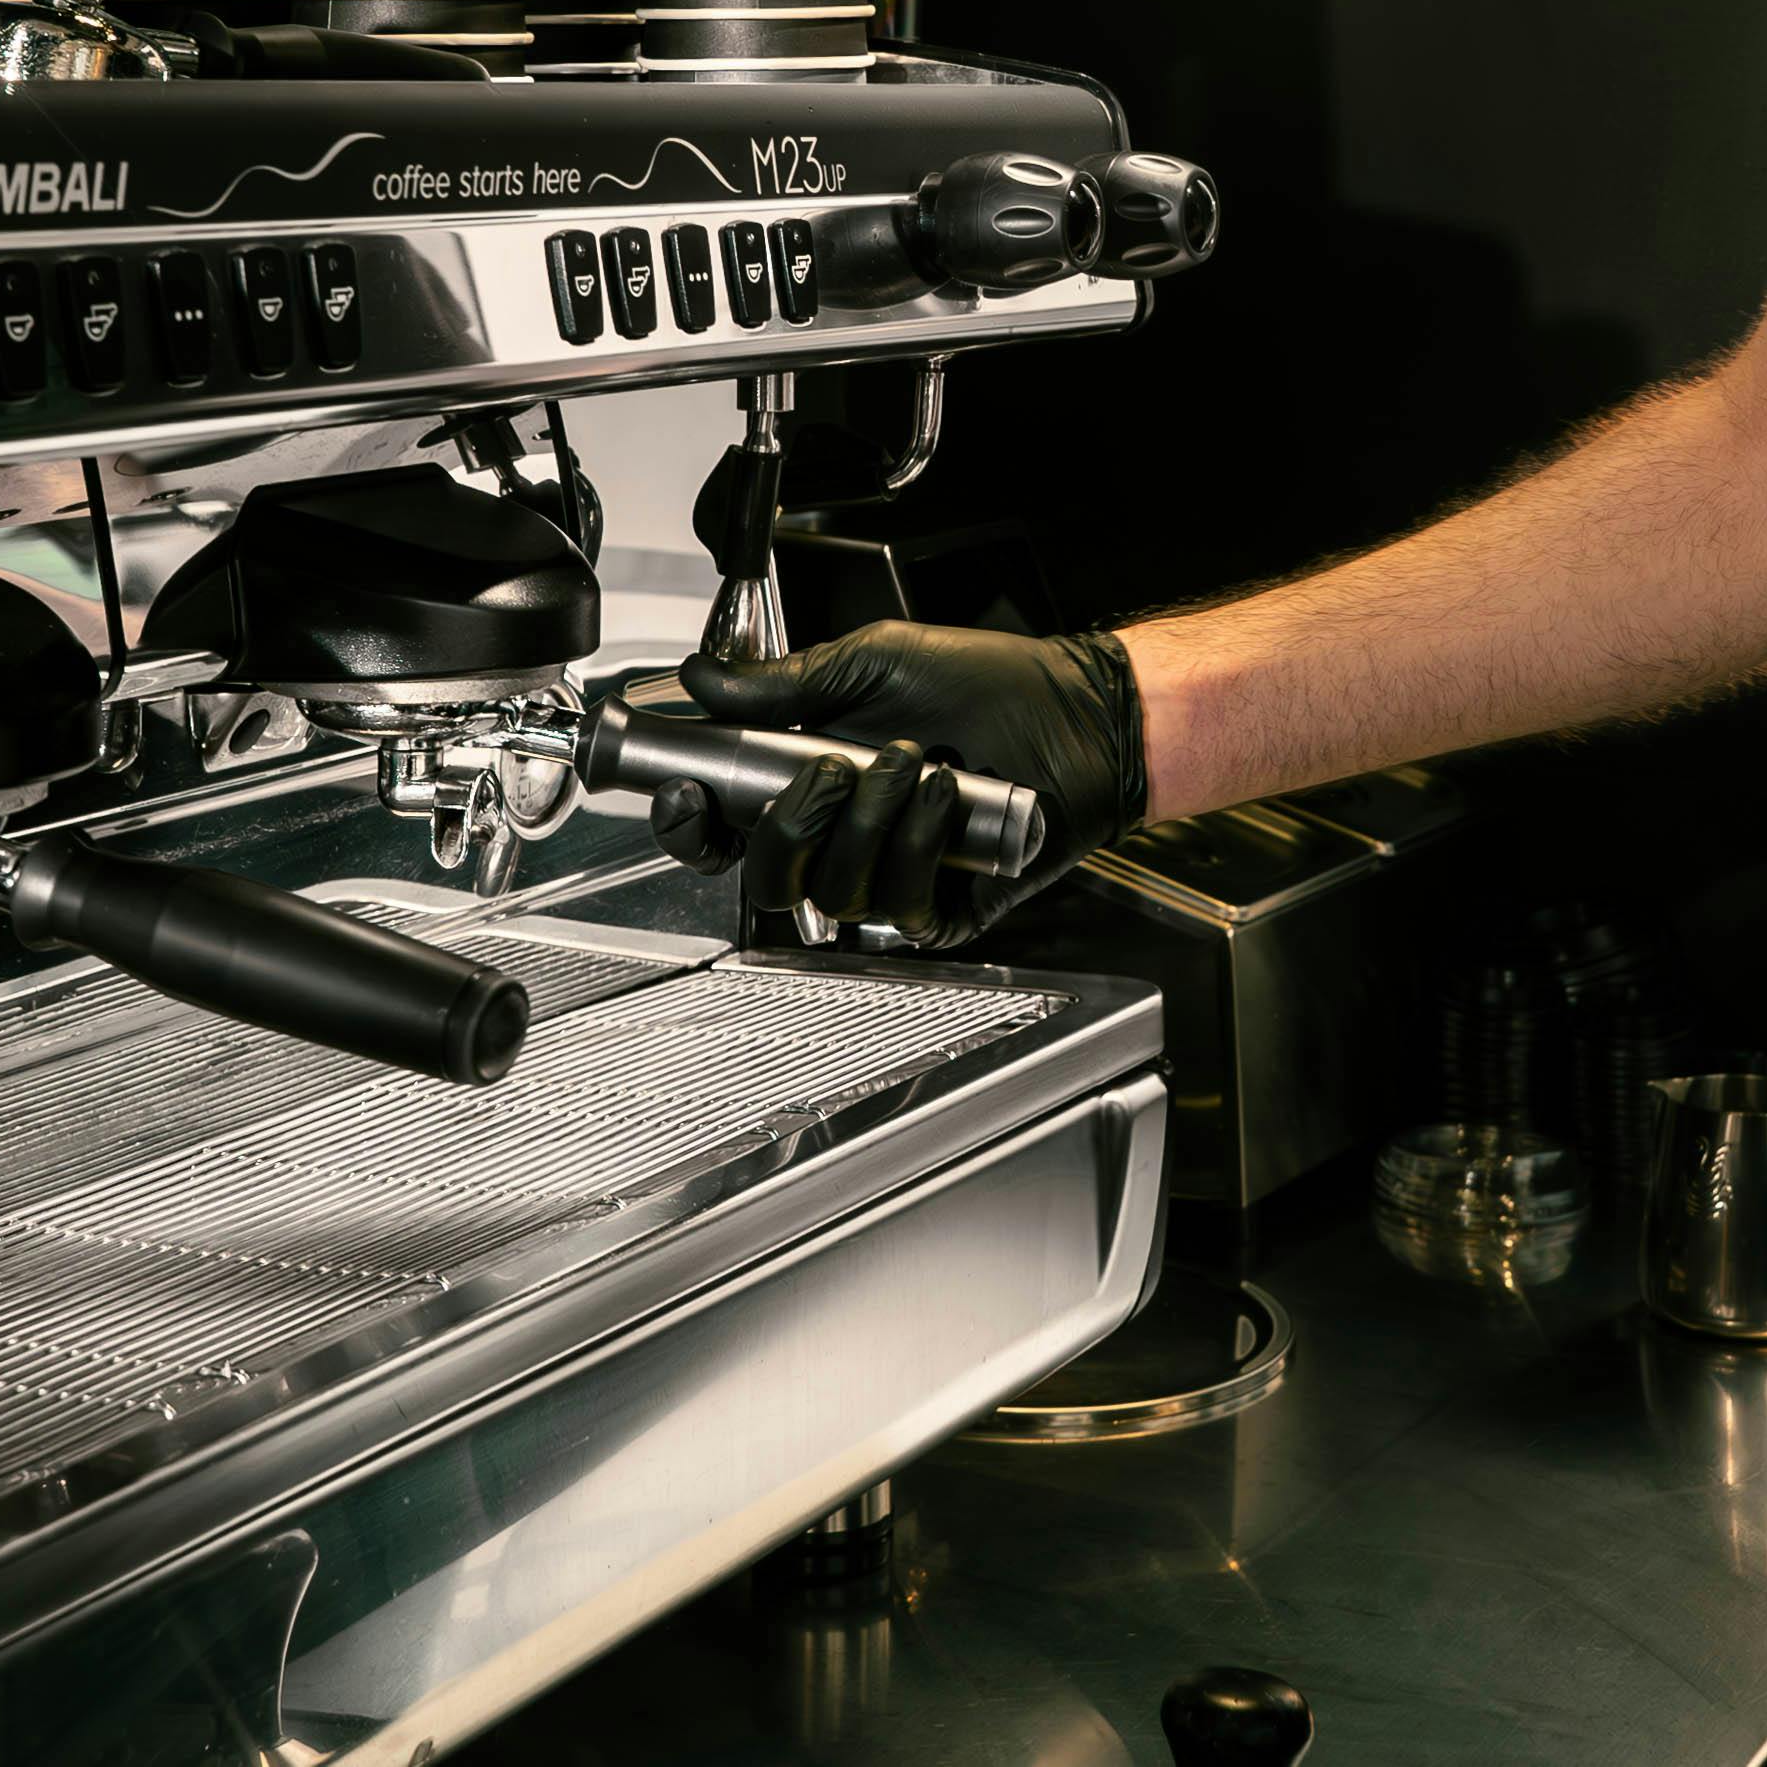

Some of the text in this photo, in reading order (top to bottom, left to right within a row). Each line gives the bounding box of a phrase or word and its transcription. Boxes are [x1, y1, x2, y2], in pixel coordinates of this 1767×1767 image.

[371, 161, 582, 201] coffee starts here
